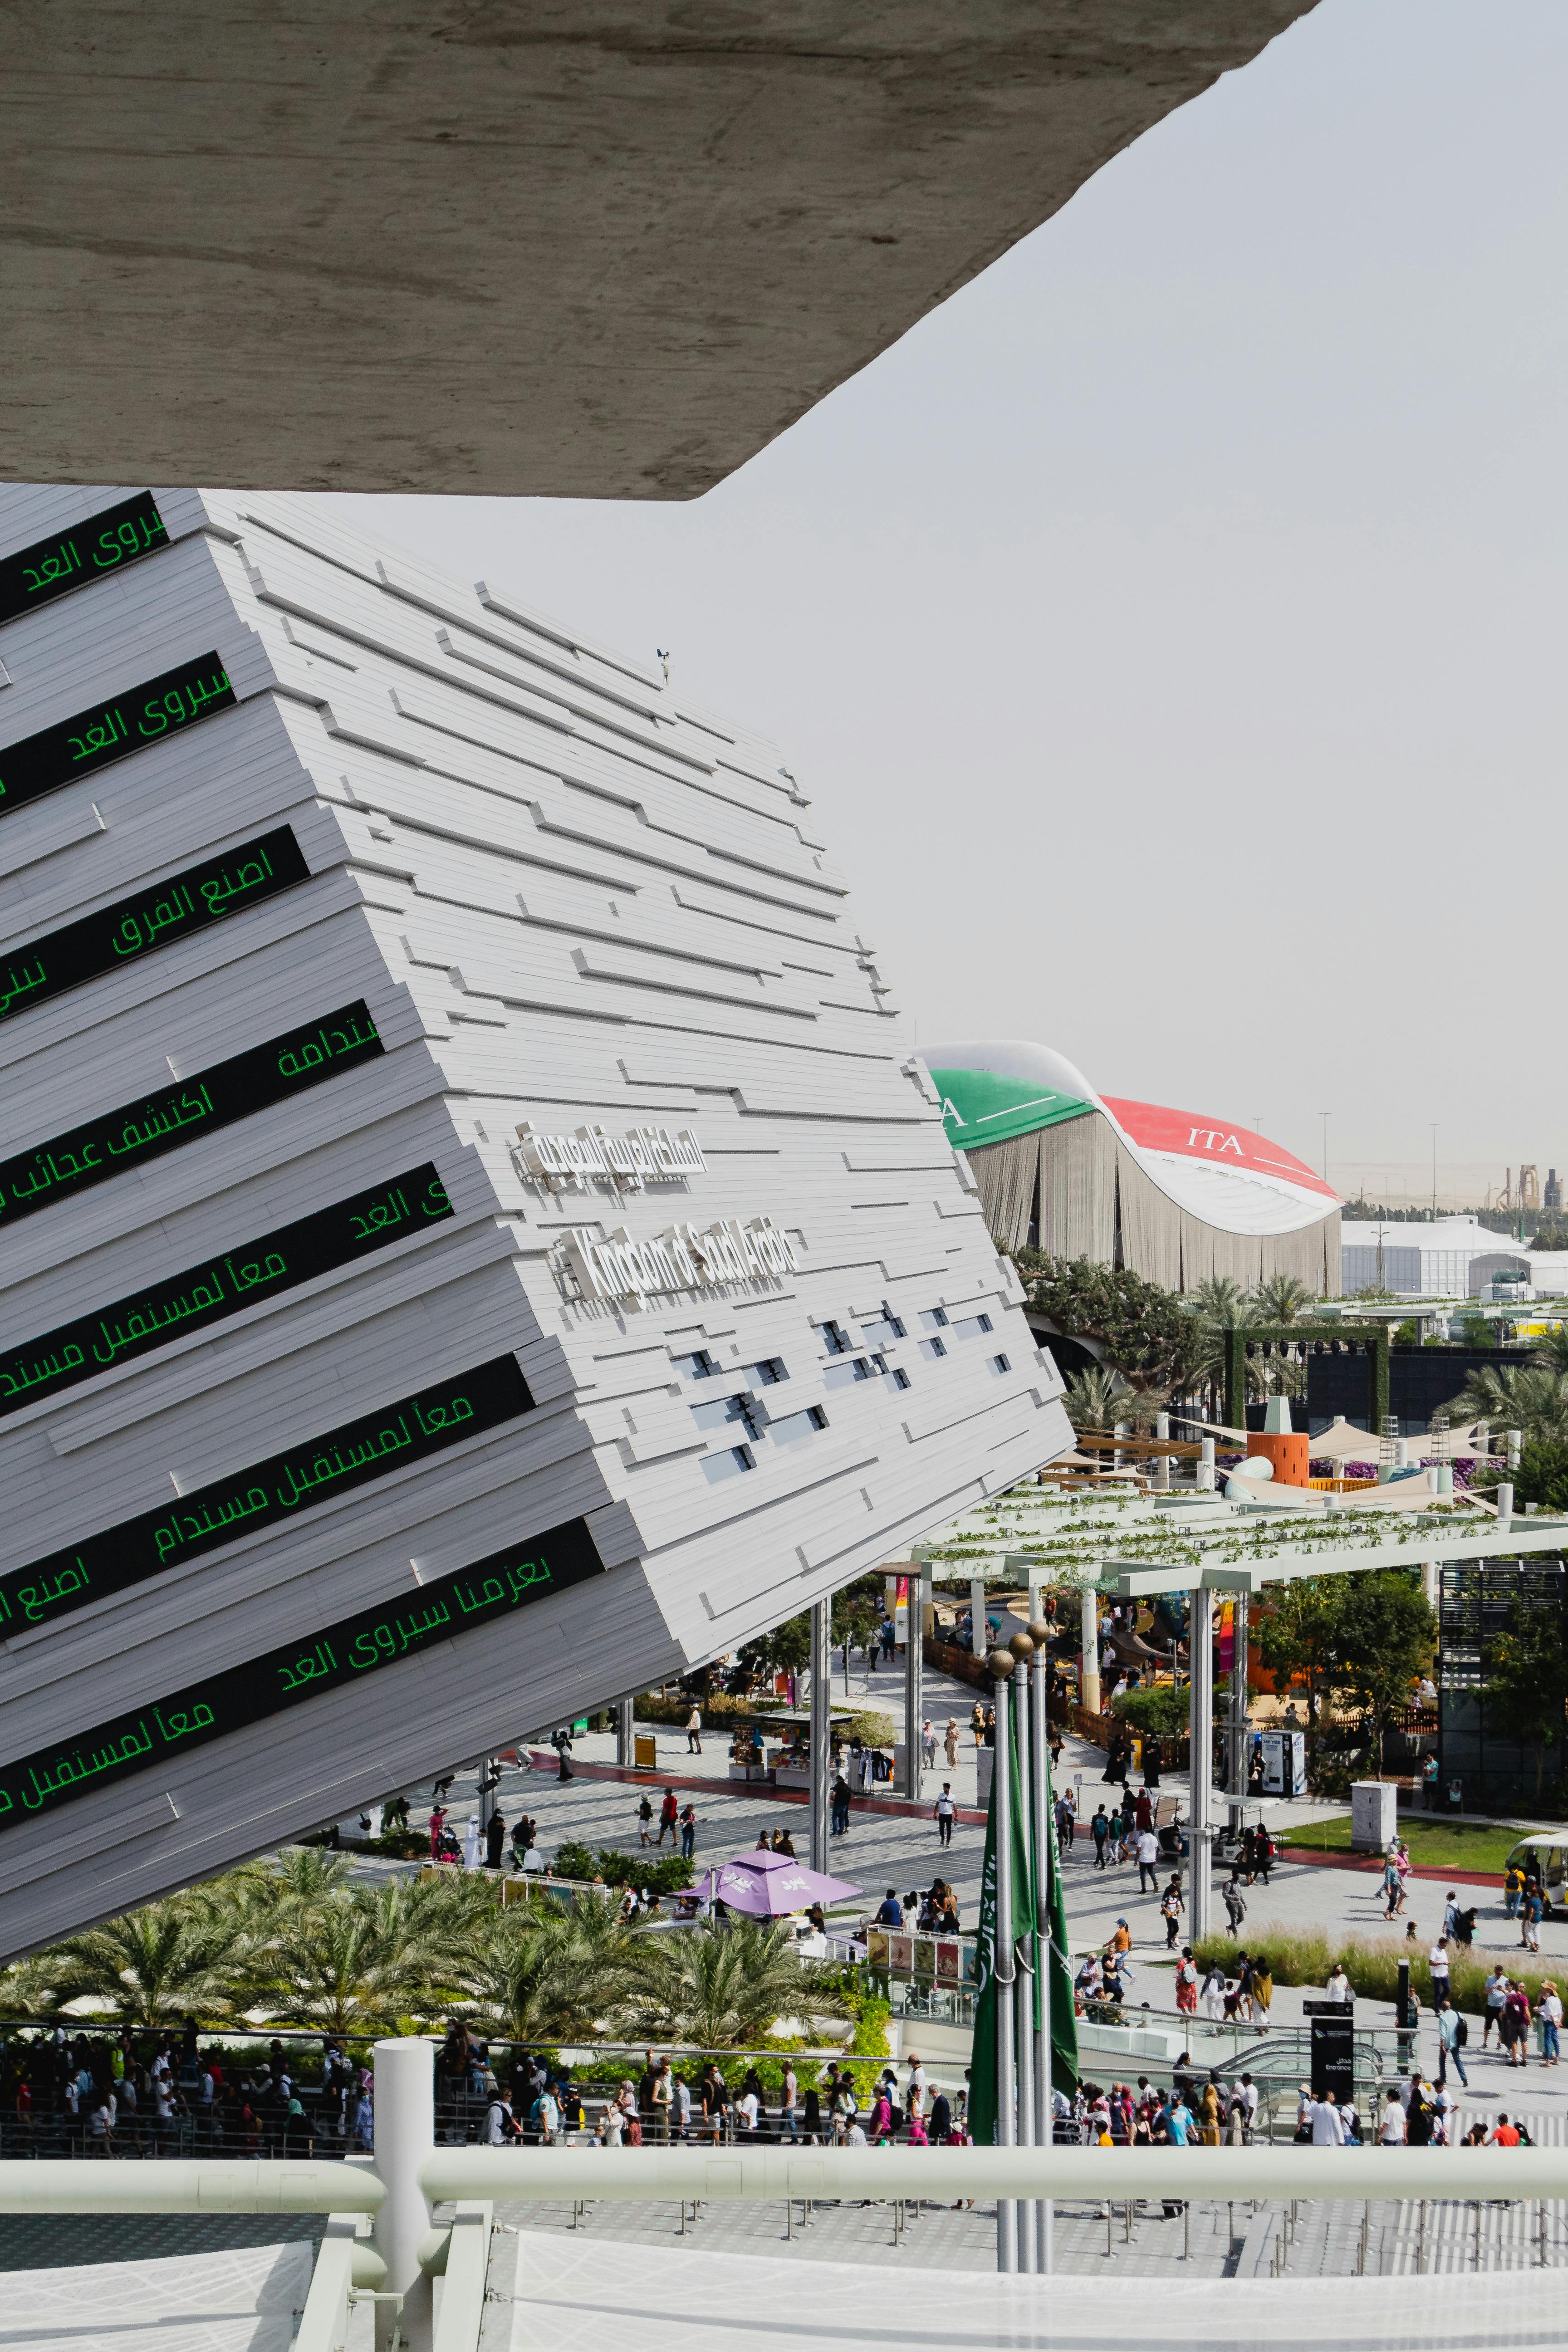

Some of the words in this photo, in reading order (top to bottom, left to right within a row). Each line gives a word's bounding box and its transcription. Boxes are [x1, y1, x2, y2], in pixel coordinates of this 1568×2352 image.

[23, 541, 82, 591] الغد
[68, 709, 128, 760] الغد
[200, 849, 273, 914] اصنع
[113, 886, 194, 954] الفرق
[108, 1084, 213, 1154] اكتشف
[643, 1127, 708, 1173] المملكة
[1186, 1128, 1246, 1156] ITA
[13, 1144, 102, 1200] عجائب
[522, 1121, 611, 1190] السعودية
[595, 1124, 658, 1189] العربية
[351, 1190, 410, 1239] الغد
[567, 1226, 681, 1310] Kingdom
[672, 1223, 701, 1285] of
[686, 1220, 749, 1282] Saudi
[734, 1217, 799, 1276] Arabia
[93, 1272, 225, 1362] لمستقبل
[277, 1416, 412, 1506] لمستقبل
[155, 1488, 269, 1563] مستدام
[18, 1557, 89, 1620] اصنع
[278, 1641, 337, 1690] الغد
[22, 1721, 152, 1808] لمستقبل
